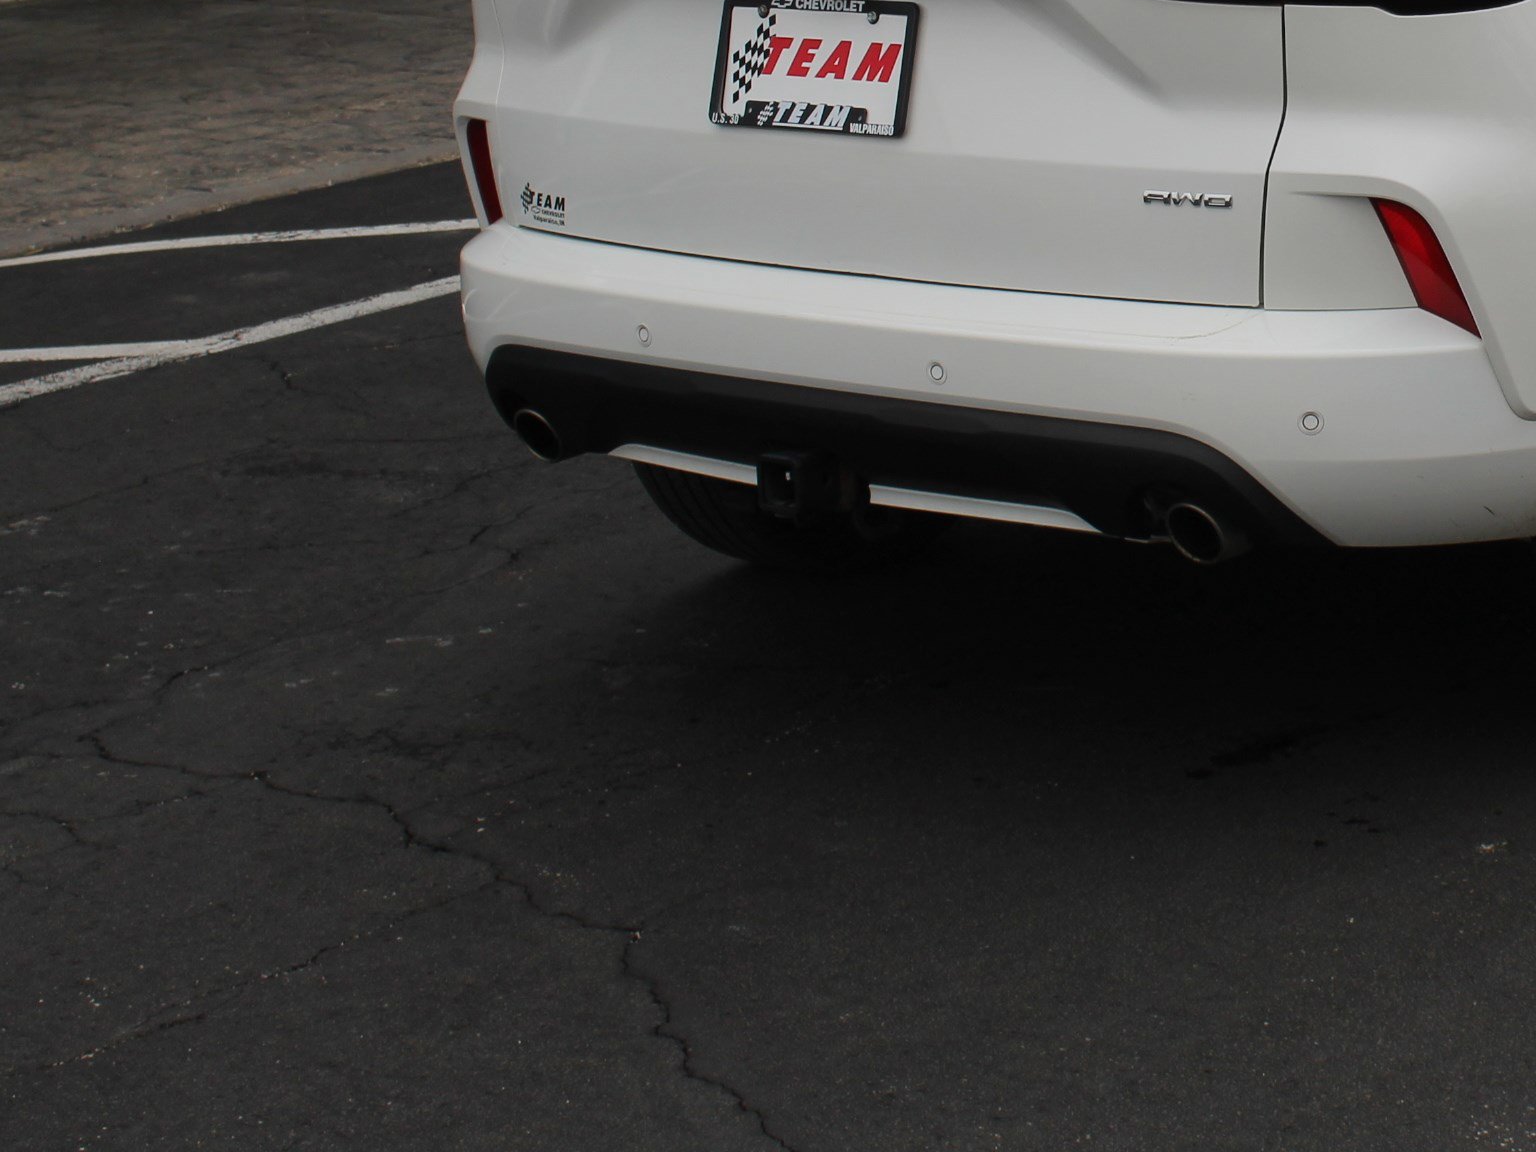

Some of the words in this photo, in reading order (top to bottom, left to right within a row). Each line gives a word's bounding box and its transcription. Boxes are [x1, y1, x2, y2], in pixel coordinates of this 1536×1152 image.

[761, 36, 902, 83] TEAM
[772, 101, 851, 128] TEAM
[849, 122, 894, 136] VALPARAISO
[529, 191, 565, 211] TEAM
[1143, 189, 1233, 208] AWD
